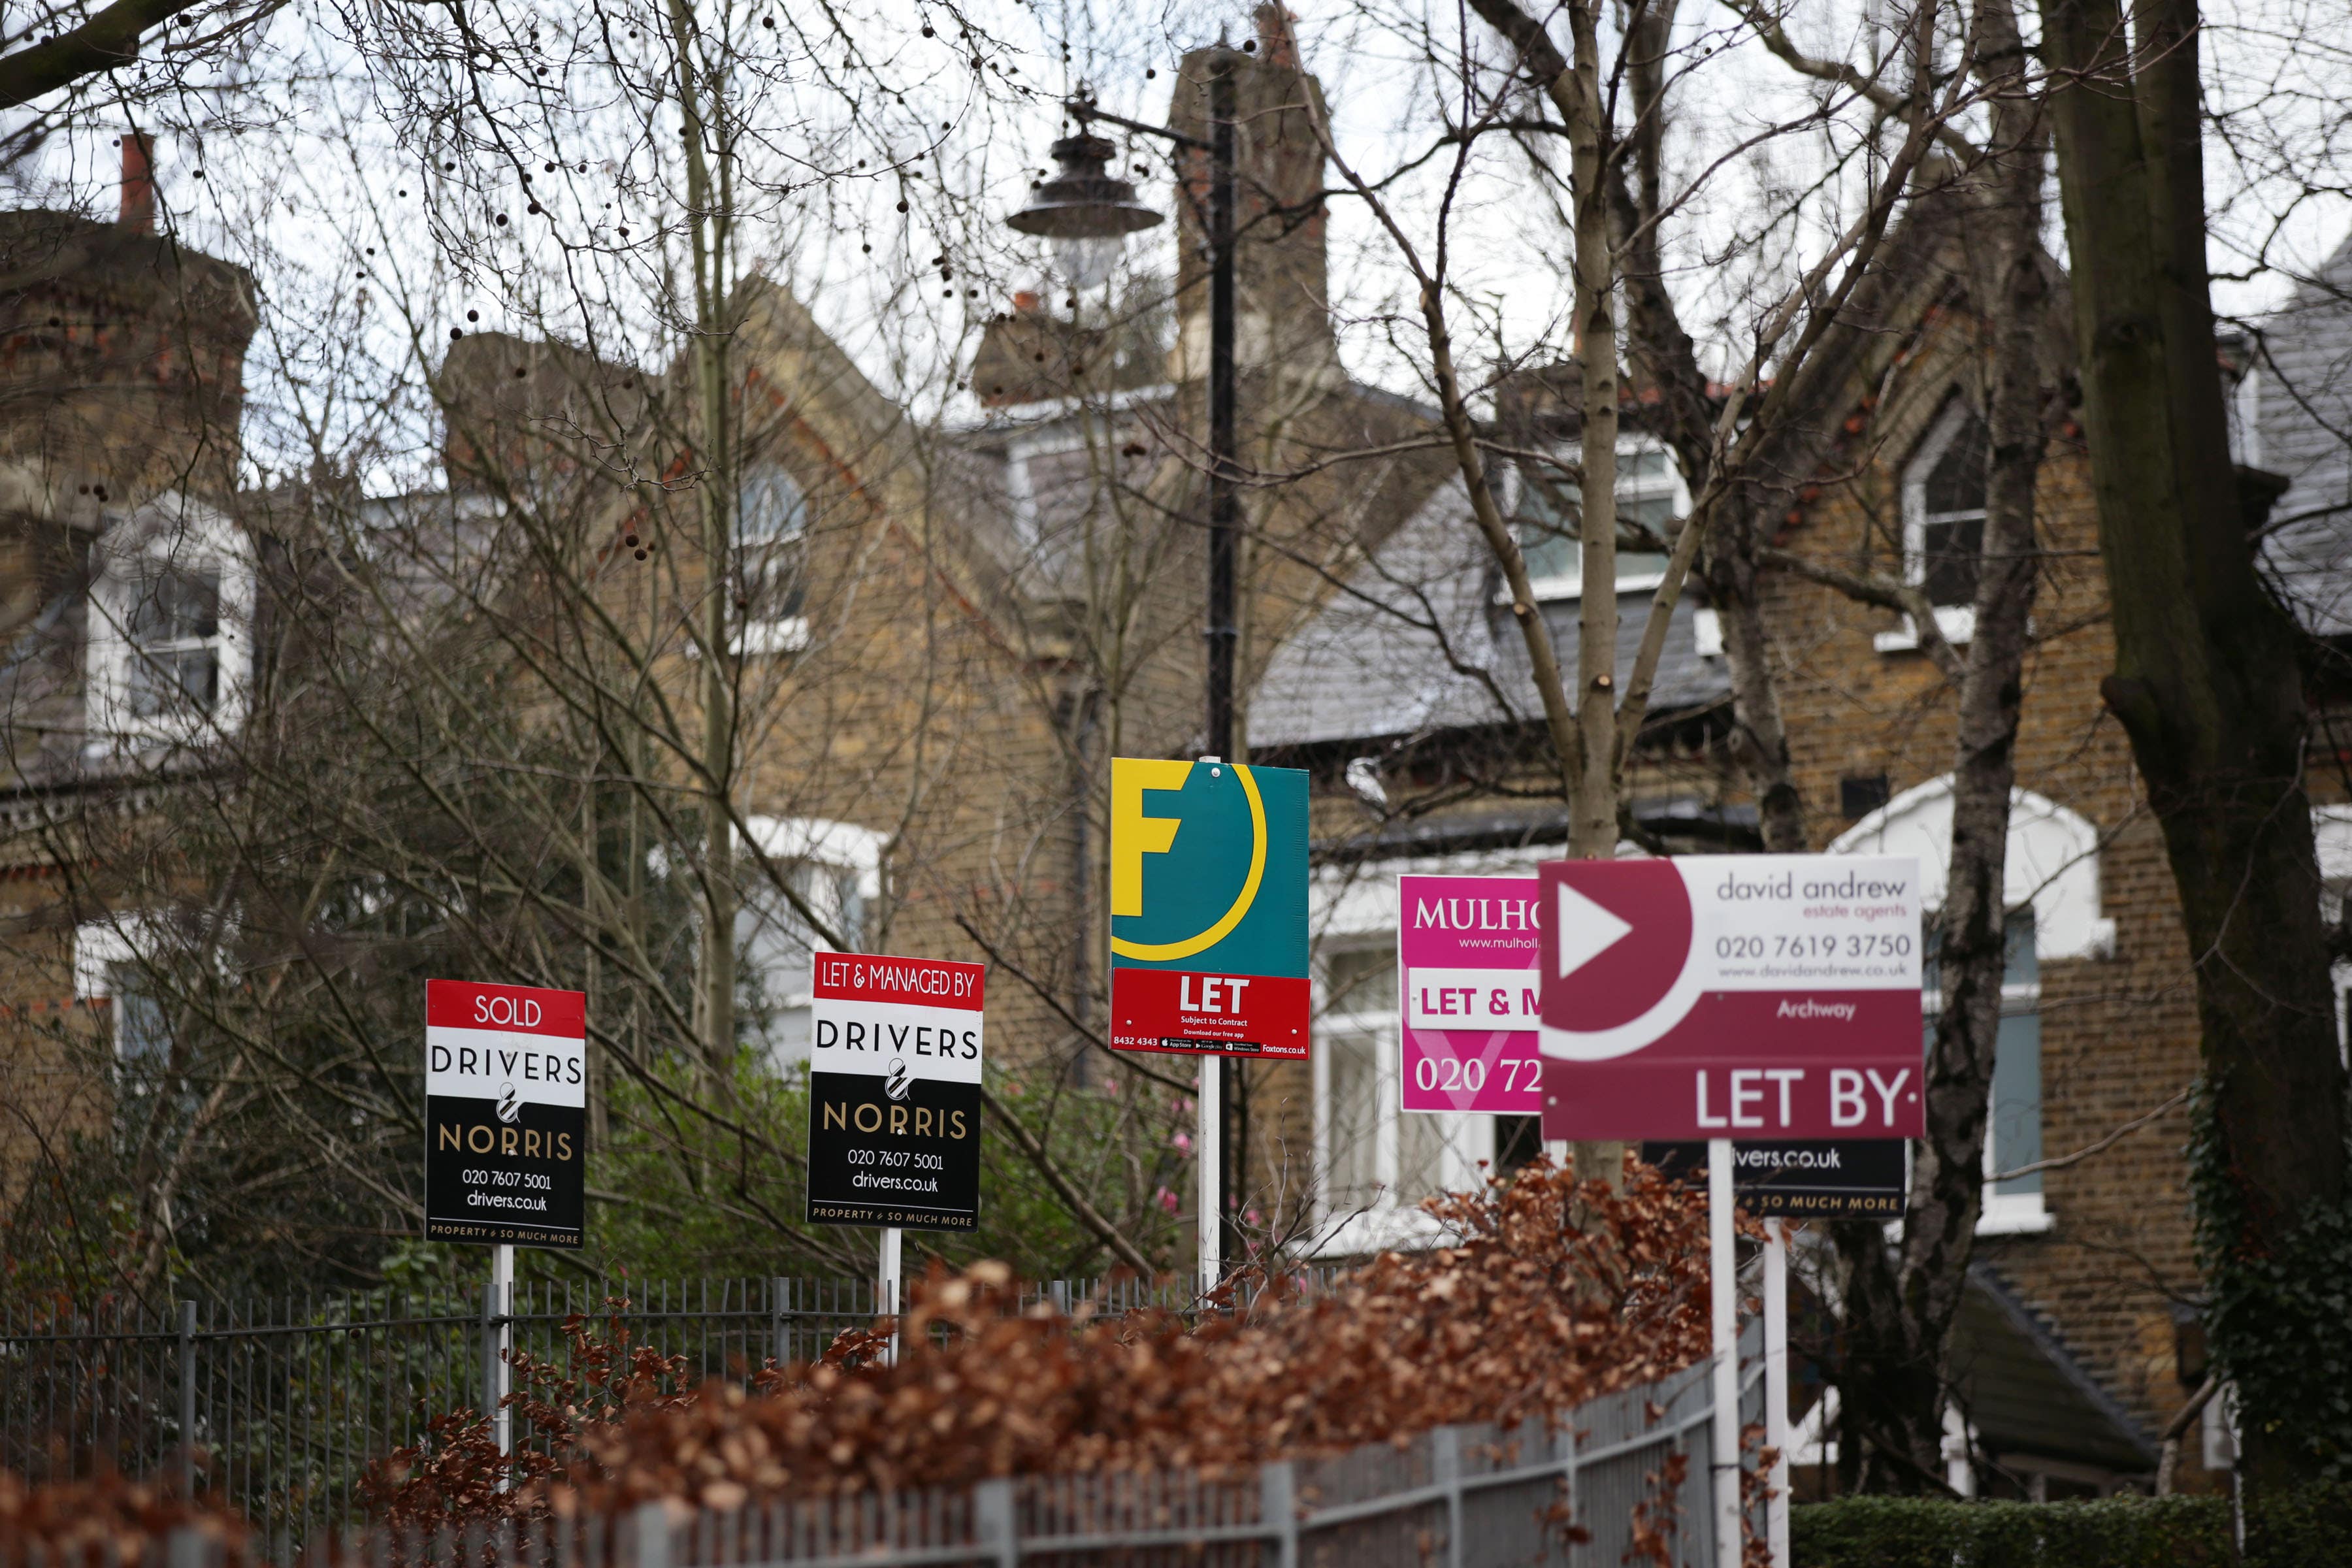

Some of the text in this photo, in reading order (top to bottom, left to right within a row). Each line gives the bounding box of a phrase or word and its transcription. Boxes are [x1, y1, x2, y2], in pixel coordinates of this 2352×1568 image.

[1717, 870, 1906, 900] david andrew
[1803, 904, 1907, 922] estate agents
[1459, 938, 1541, 948] www.mulholl
[1716, 934, 1911, 959] 020 7619 3750
[823, 962, 975, 998] LET & MANAGED BY
[1718, 963, 1907, 977] www.davidandrew.co.uk
[1180, 976, 1249, 1014] LET
[1422, 988, 1477, 1015] LET
[1488, 989, 1511, 1015] &
[474, 995, 542, 1027] SOLD
[1181, 1016, 1207, 1026] Subject
[1218, 1018, 1248, 1026] Contract
[1776, 998, 1855, 1022] Archway
[817, 1019, 977, 1060] DRIVERS
[1114, 1036, 1134, 1045] 8432
[1262, 1044, 1305, 1054] Foxtons.co.uk
[432, 1045, 581, 1085] DRIVERS
[1416, 1057, 1486, 1092] 020
[1697, 1068, 1910, 1128] LET BY
[823, 1101, 966, 1139] NORRIS
[439, 1123, 572, 1160] NORRIS
[848, 1149, 943, 1169] 020 7607 5001
[463, 1169, 551, 1190] 020 7607 5001
[853, 1171, 938, 1192] drivers.co.uk
[467, 1190, 547, 1211] drivers.co.uk
[1761, 1196, 1782, 1207] SO
[1790, 1196, 1841, 1209] MUCH
[1848, 1198, 1897, 1210] MORE
[813, 1208, 873, 1219] PROPERTY
[888, 1213, 902, 1221] SO
[906, 1214, 938, 1224] MUCH
[941, 1216, 972, 1226] MORE
[431, 1225, 487, 1236] PROPERTY
[500, 1230, 514, 1238] SO
[517, 1231, 546, 1241] MUCH
[550, 1233, 579, 1244] MORE
